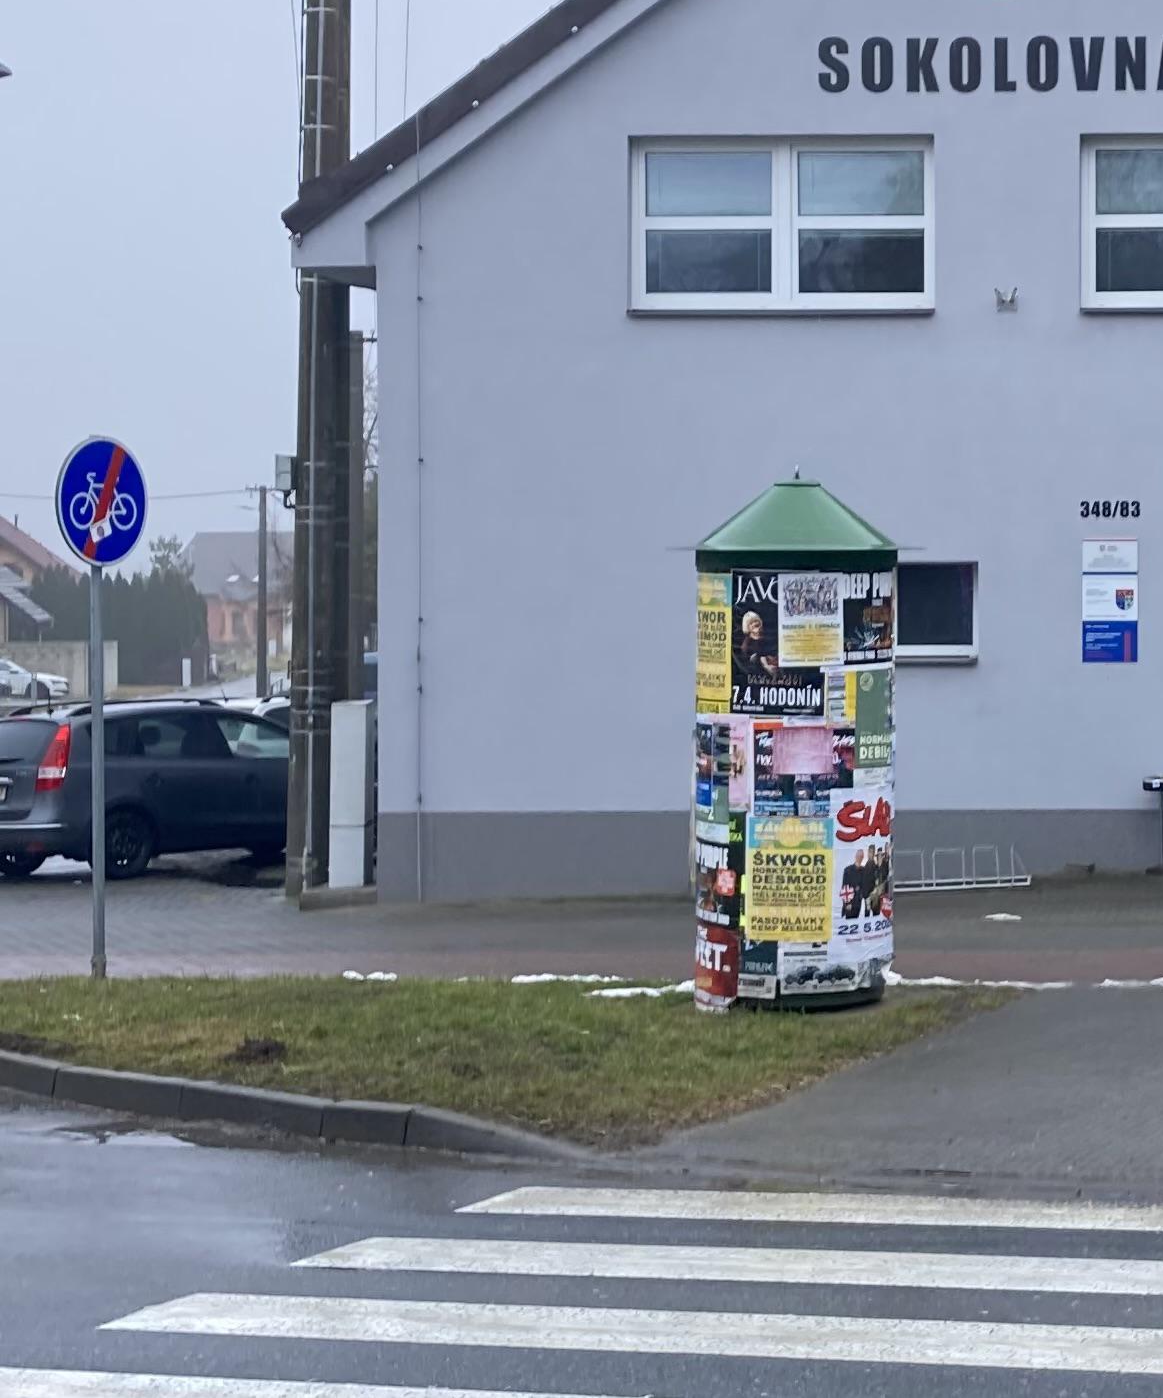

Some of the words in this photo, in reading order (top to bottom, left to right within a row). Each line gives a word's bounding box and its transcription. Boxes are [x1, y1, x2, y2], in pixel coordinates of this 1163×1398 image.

[1080, 500, 1141, 519] 348/83
[759, 684, 821, 707] HODONÍN
[753, 850, 826, 867] ŠKWOR
[752, 874, 827, 885] DESMOD
